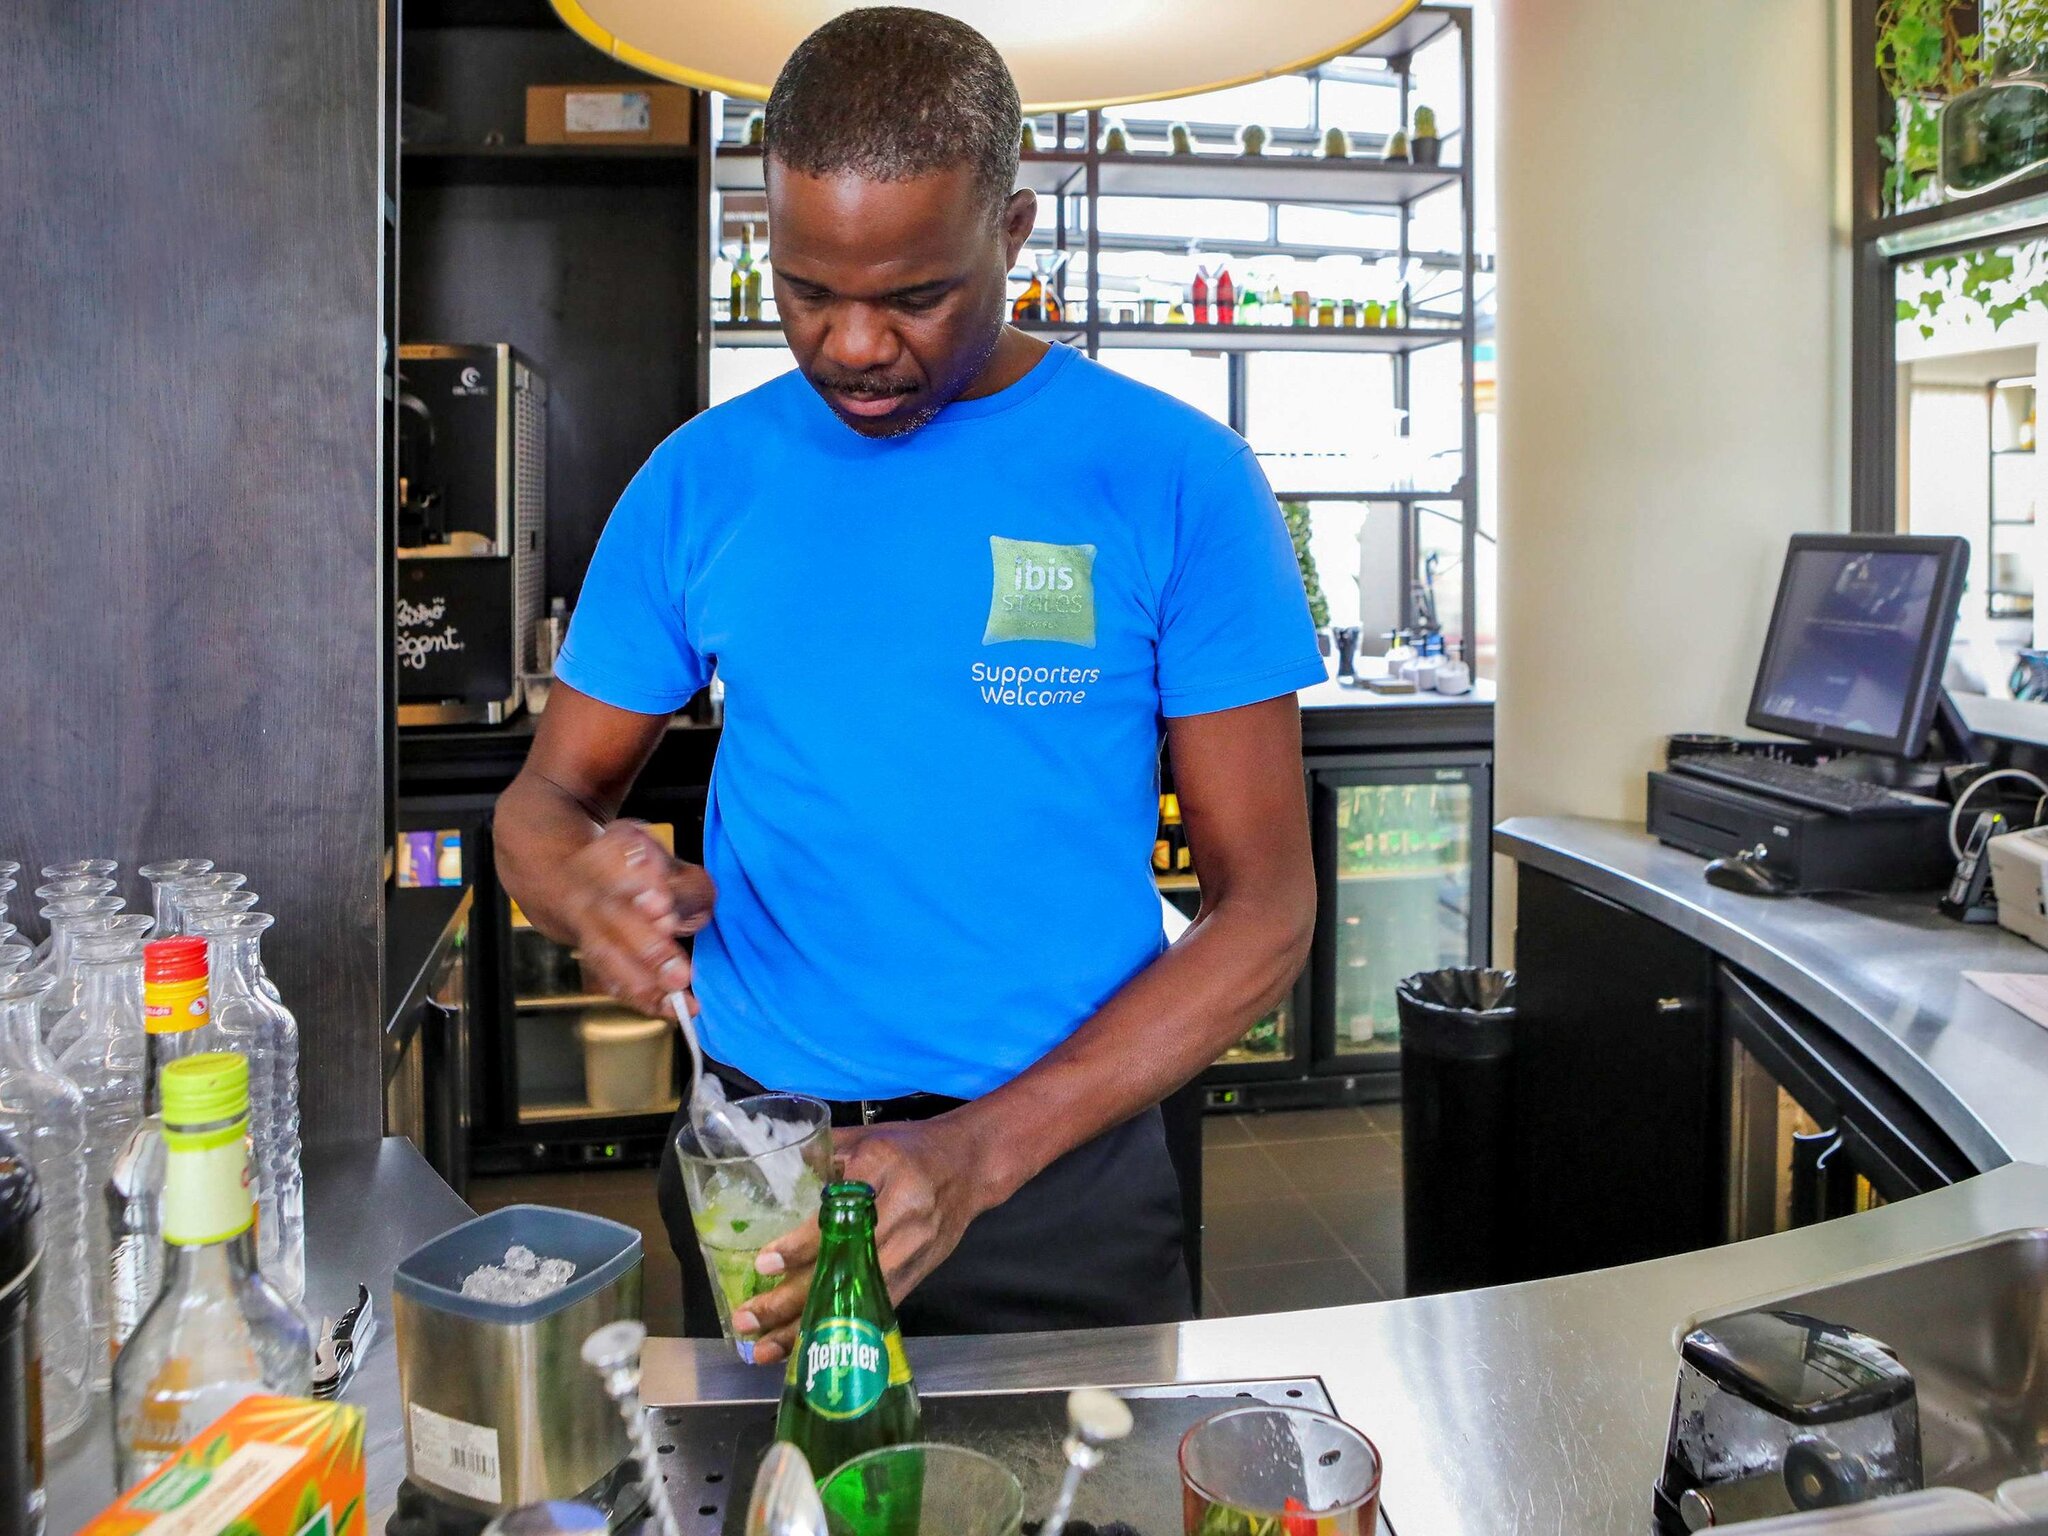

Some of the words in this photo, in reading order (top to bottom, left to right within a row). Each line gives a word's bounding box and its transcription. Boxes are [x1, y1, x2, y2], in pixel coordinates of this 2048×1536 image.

[1014, 556, 1074, 592] ibis
[971, 662, 1100, 687] Supporters
[980, 686, 1086, 707] Welcome
